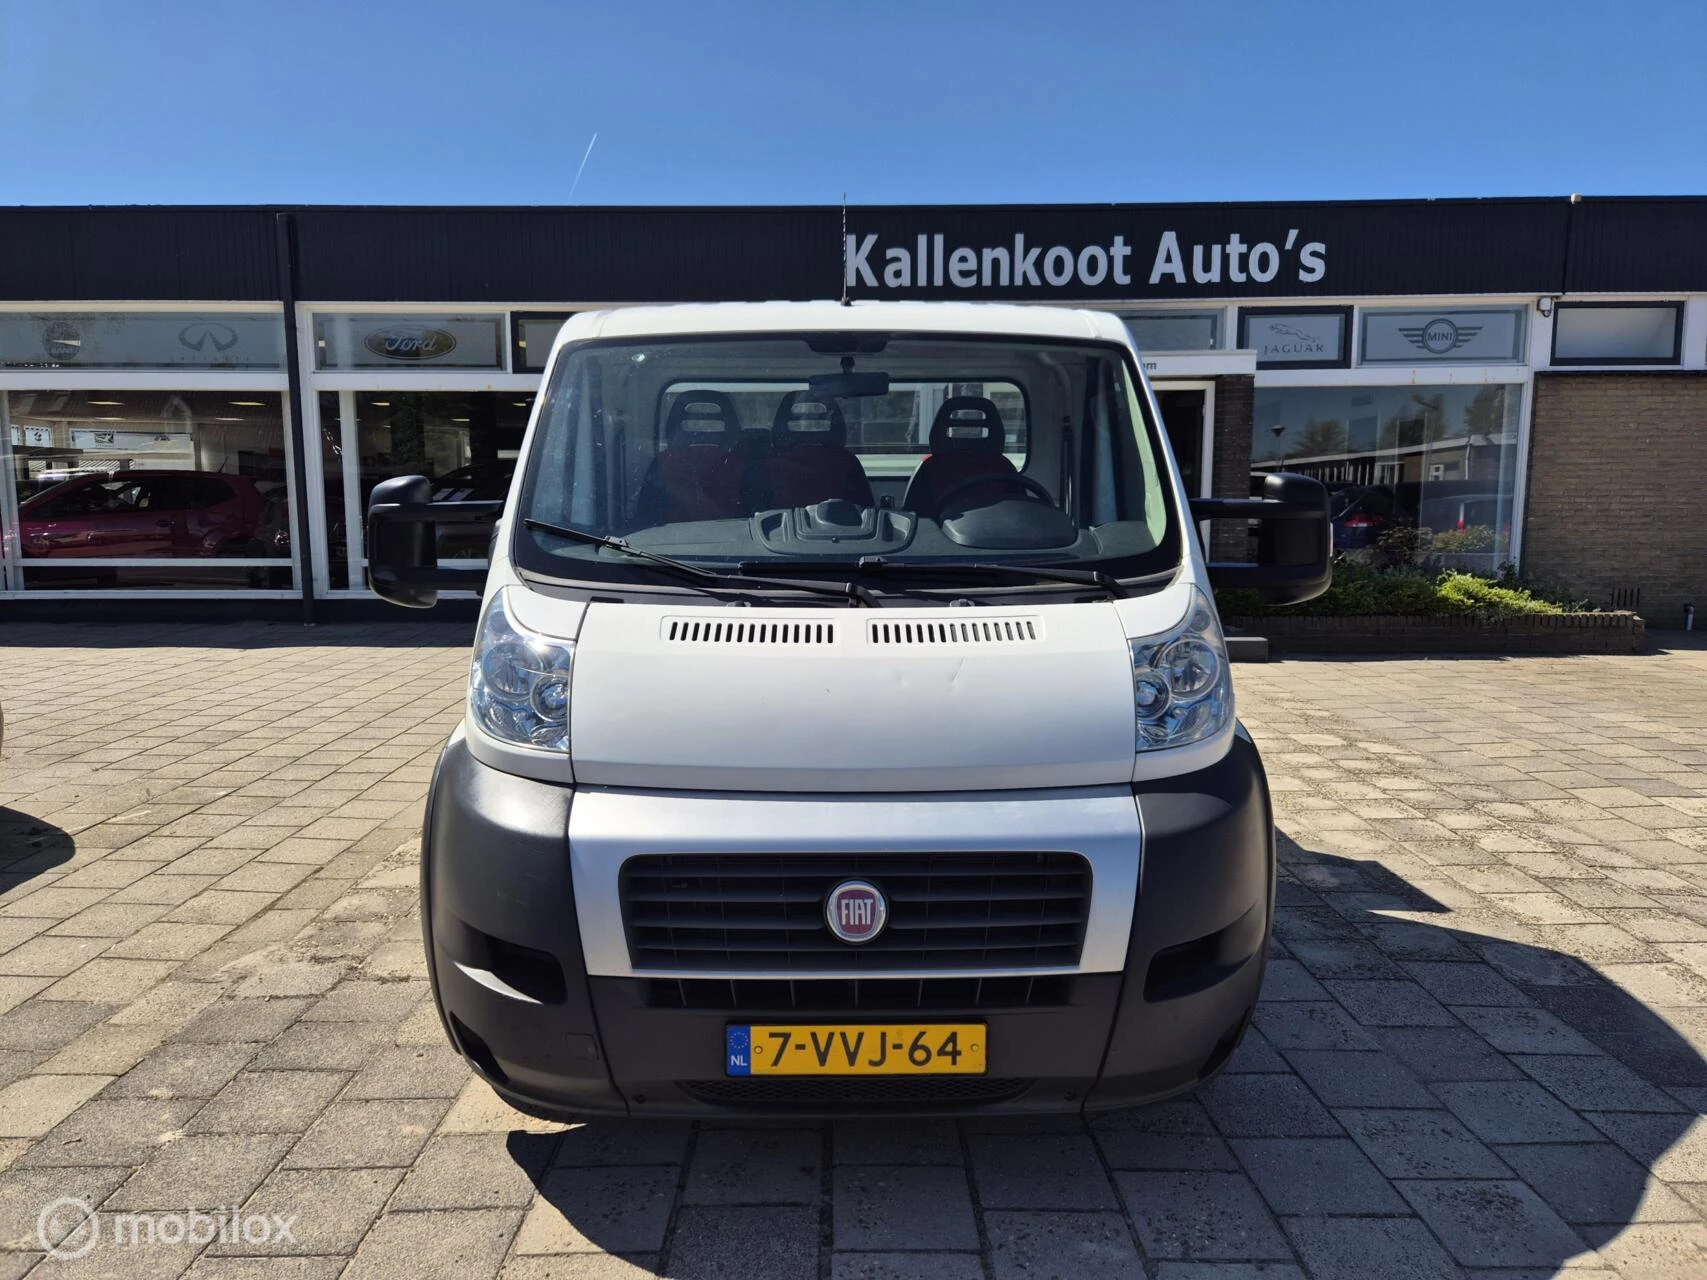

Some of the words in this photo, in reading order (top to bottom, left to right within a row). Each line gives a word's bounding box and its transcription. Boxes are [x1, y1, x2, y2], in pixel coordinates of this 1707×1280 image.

[846, 233, 1131, 288] Kallenkoot
[1149, 229, 1326, 283] Auto's
[385, 332, 437, 351] Ford
[1427, 331, 1453, 342] MINI
[1263, 343, 1325, 355] JAGUAR
[840, 898, 874, 926] FIAT
[730, 1055, 748, 1067] NL
[768, 1030, 963, 1068] 7-VVJ-64
